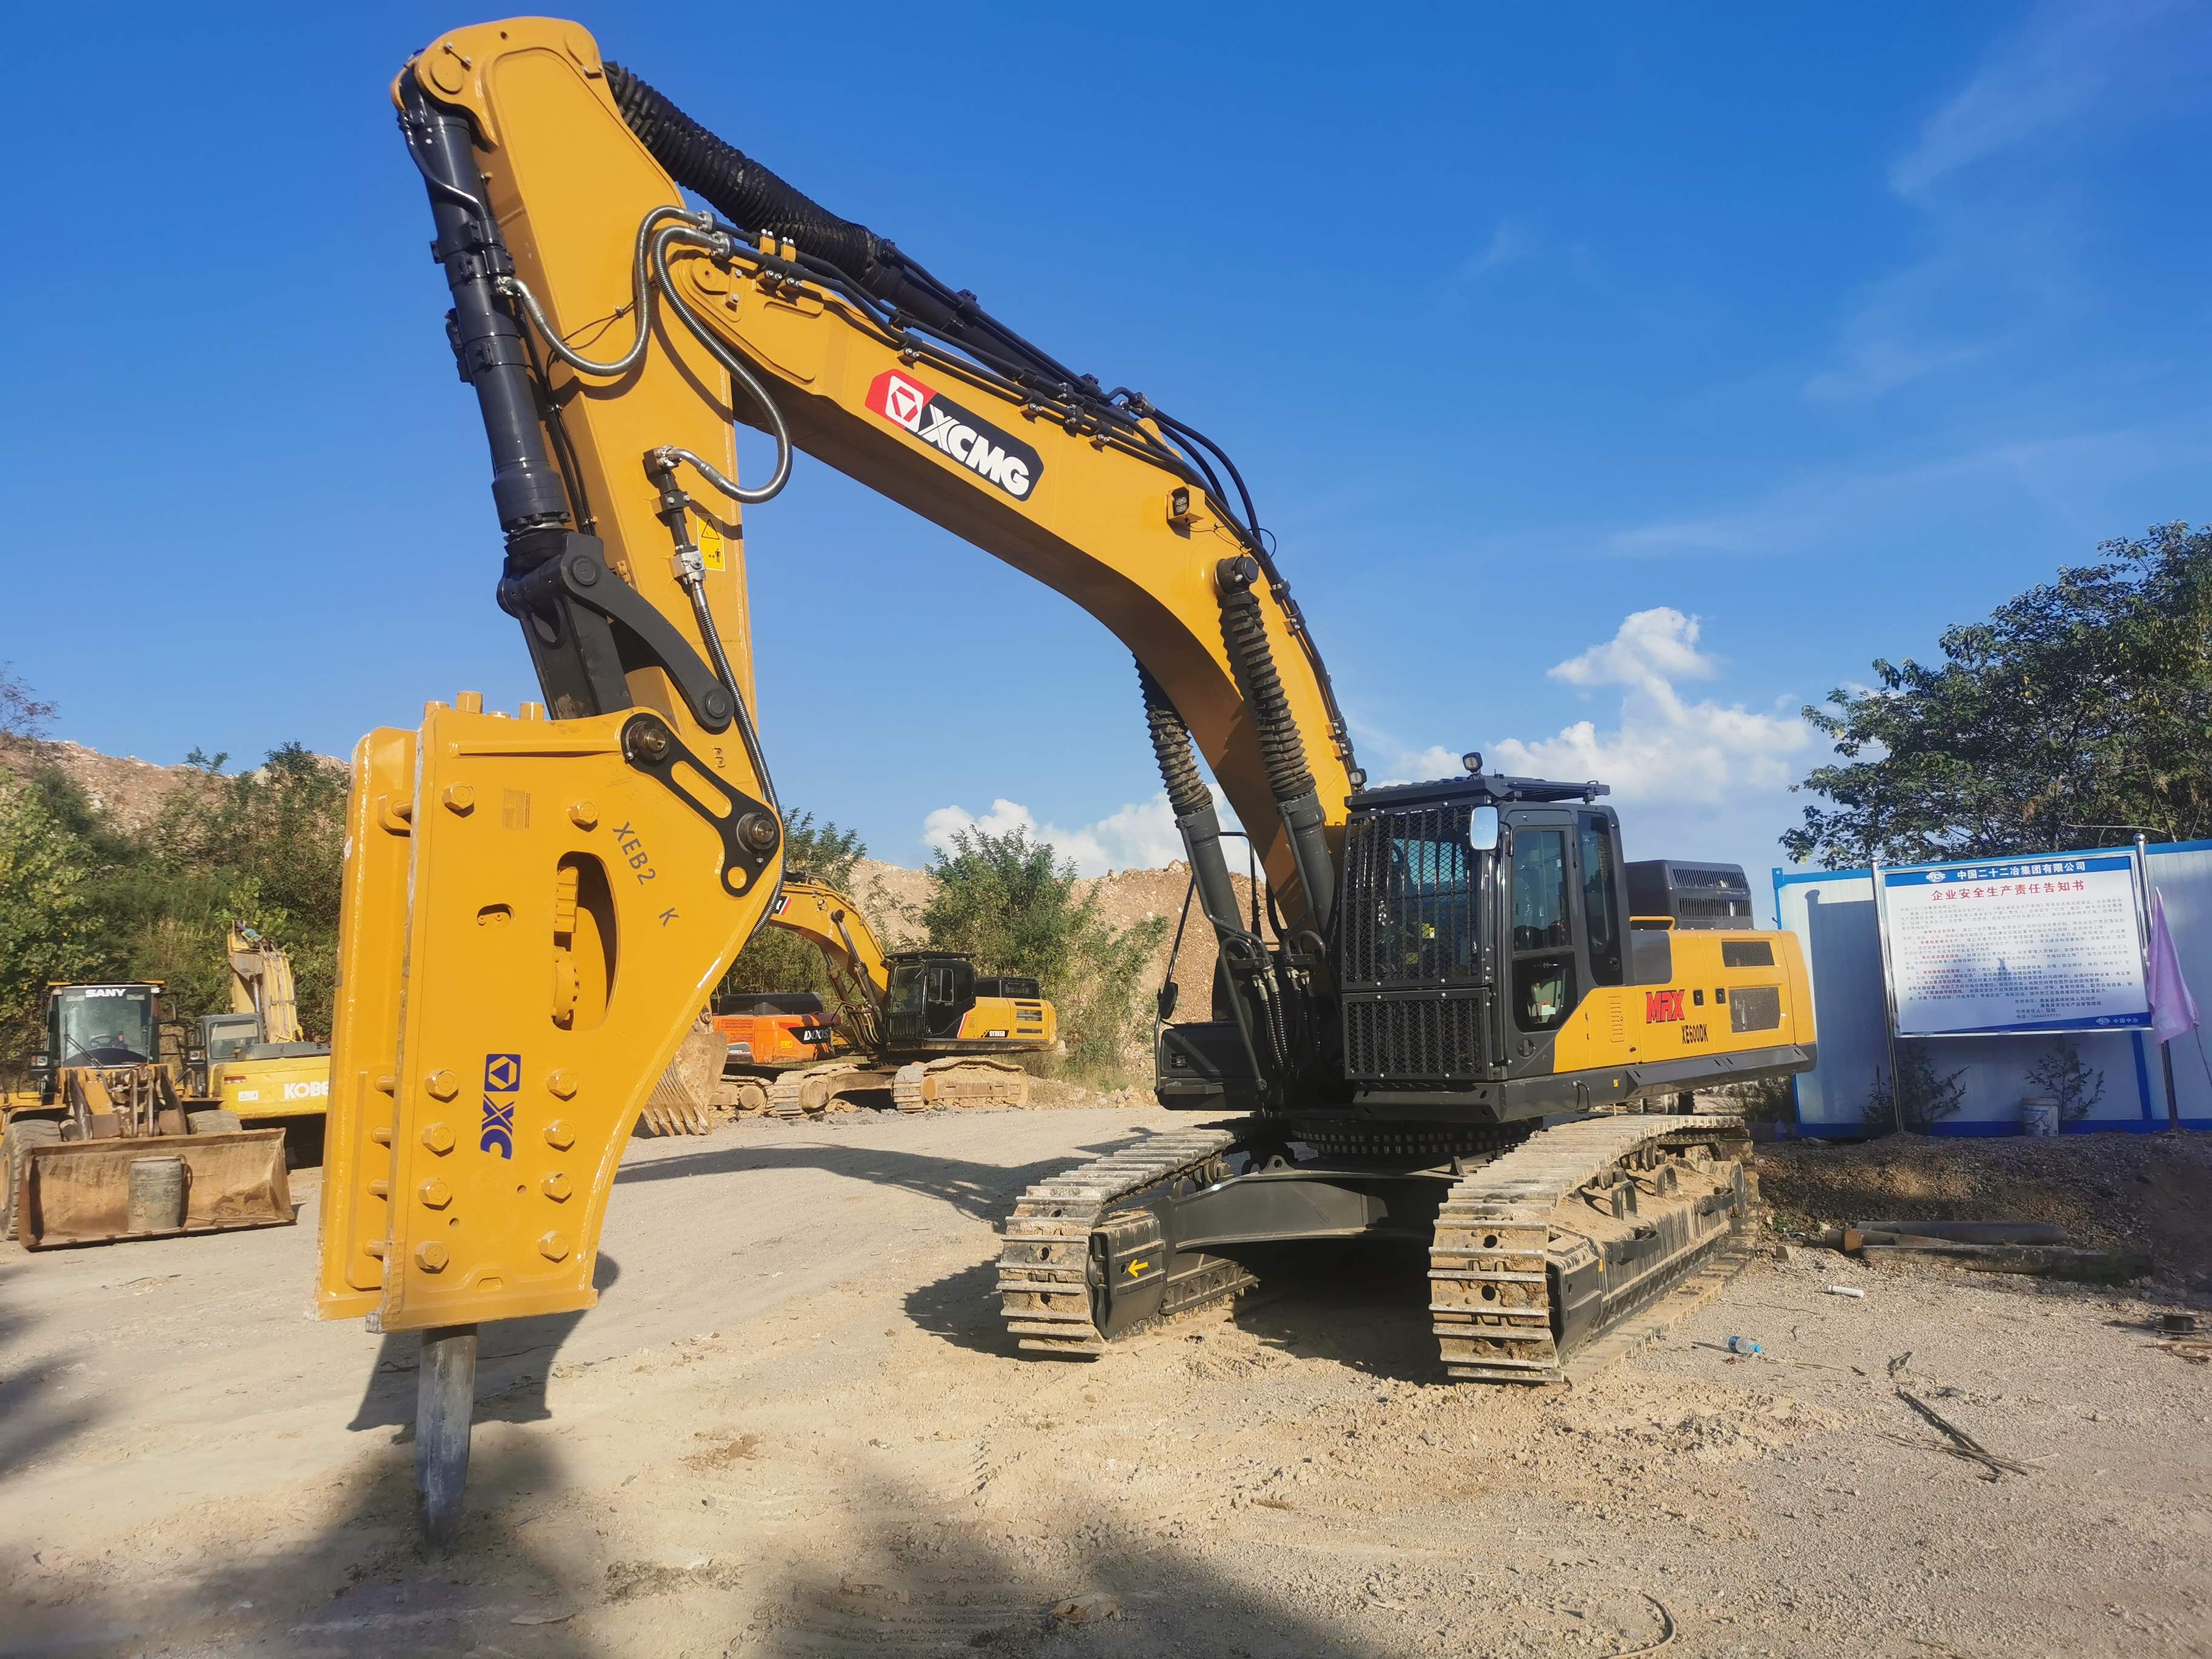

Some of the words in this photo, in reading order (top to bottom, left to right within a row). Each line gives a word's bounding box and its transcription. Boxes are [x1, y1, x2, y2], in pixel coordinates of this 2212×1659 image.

[917, 404, 1030, 495] XCMG
[612, 820, 656, 885] XEB2
[1957, 861, 2086, 879] 中国二十二冶集团有限公司
[1931, 880, 2084, 900] 企业安全生产责任告知书
[659, 907, 680, 927] K
[85, 988, 127, 998] SANY
[1646, 989, 1686, 1024] MAX
[1681, 1024, 1708, 1044] XE600DK
